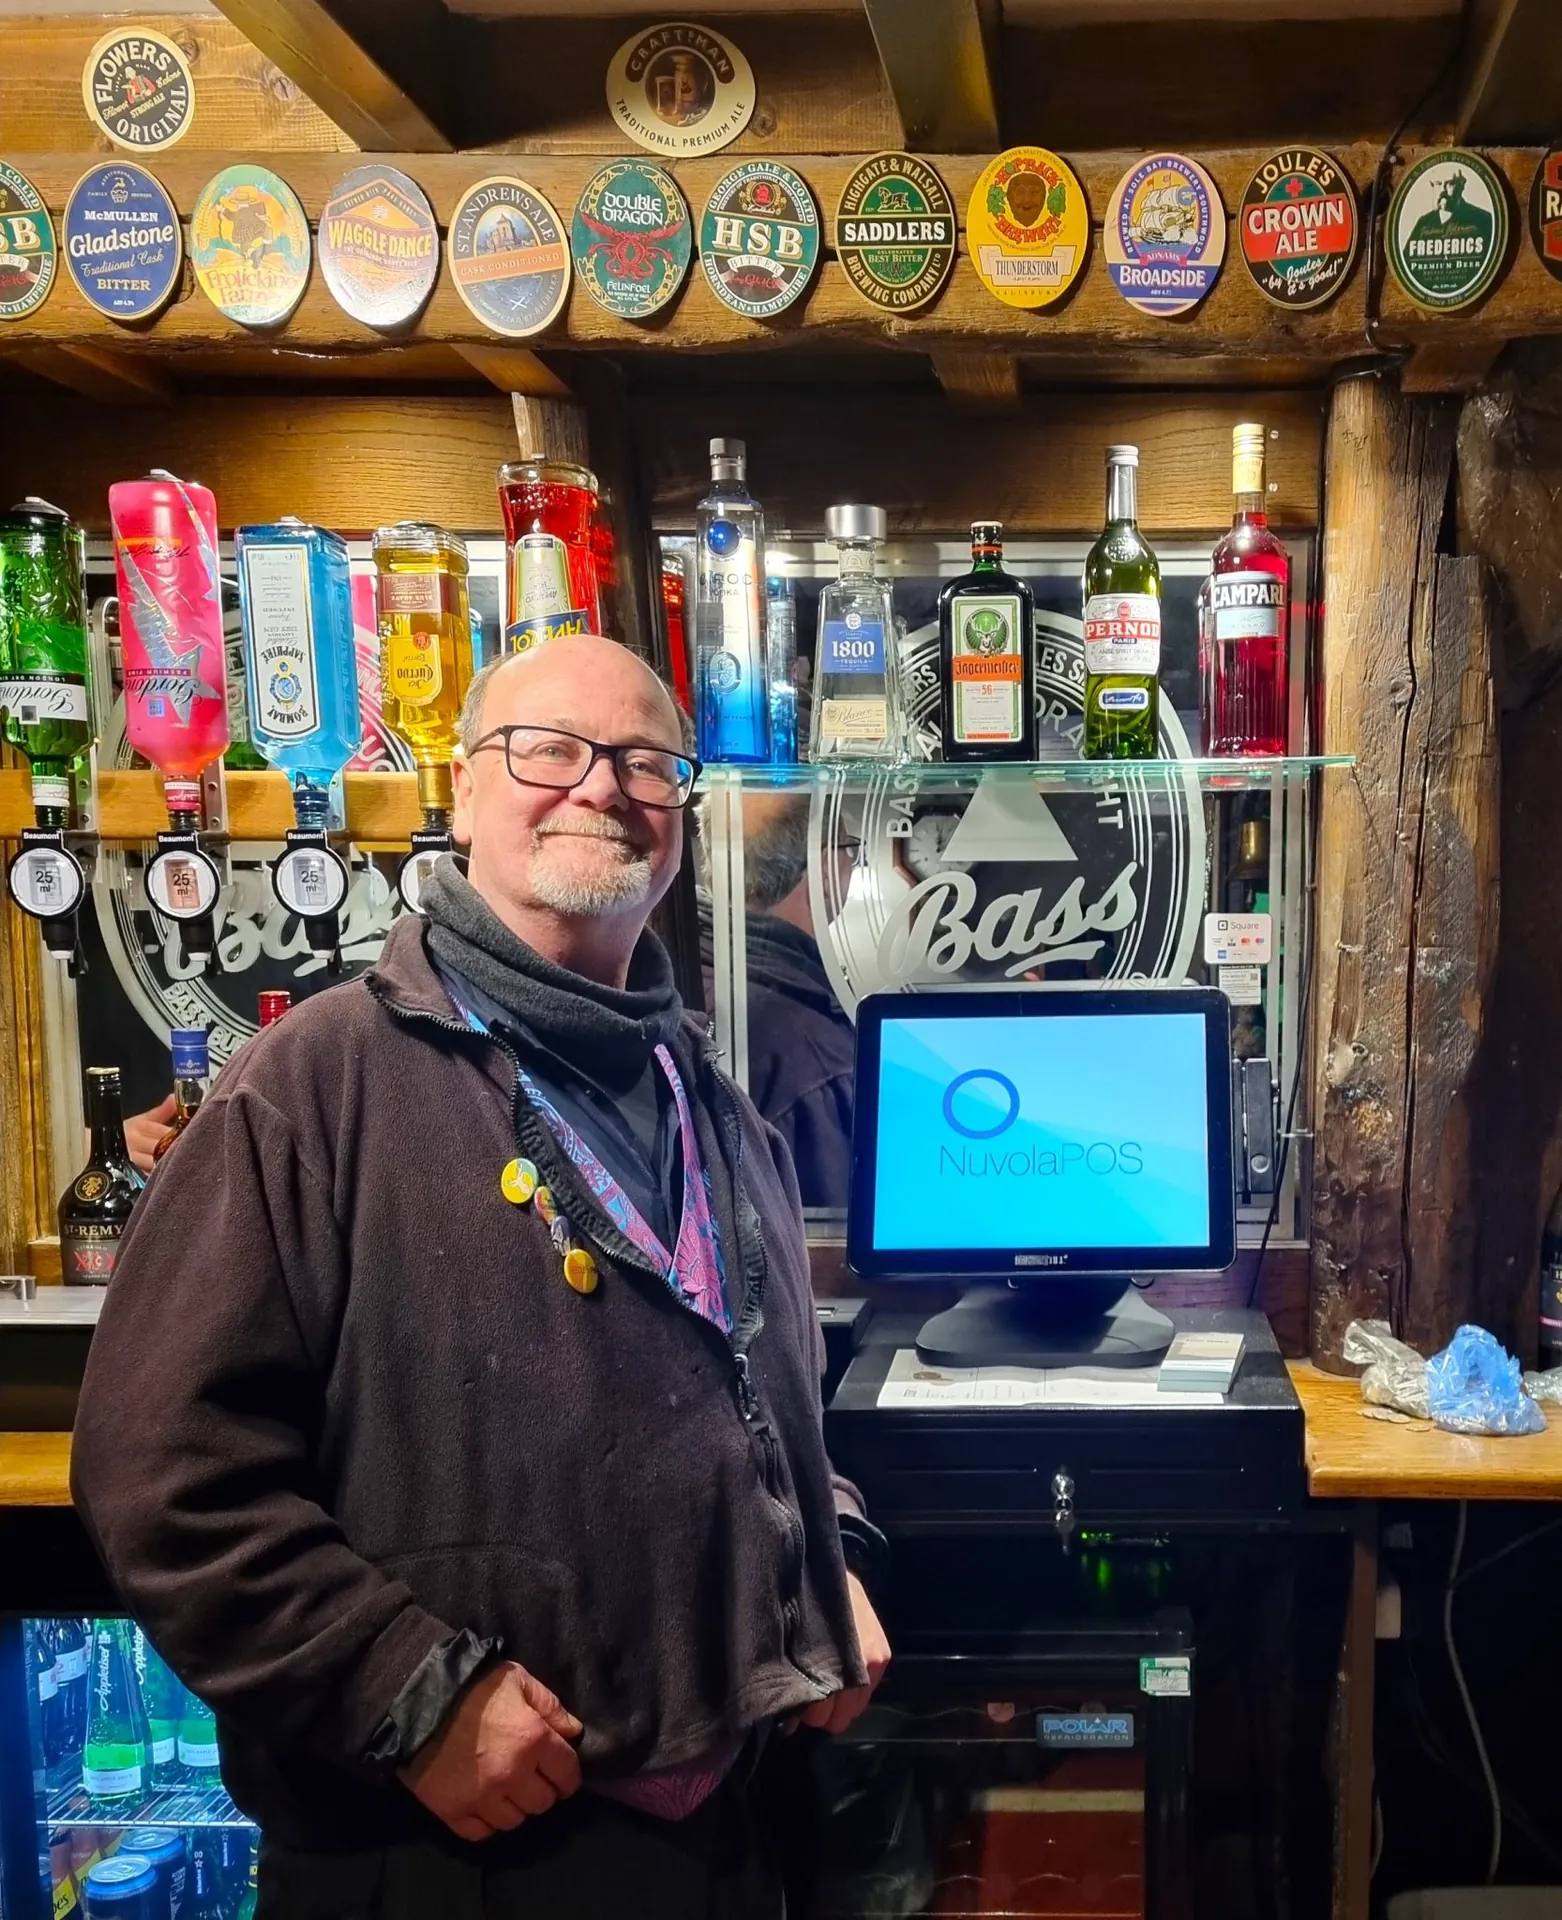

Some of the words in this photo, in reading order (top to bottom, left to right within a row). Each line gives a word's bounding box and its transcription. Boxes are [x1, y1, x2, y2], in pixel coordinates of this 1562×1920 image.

[95, 40, 172, 104] FLOWERS
[116, 84, 187, 142] ORIGINAL
[130, 98, 155, 119] STRONG
[153, 92, 166, 107] ALE
[616, 98, 677, 147] TRADITIONAL
[682, 122, 730, 147] PREMIUM
[733, 101, 745, 124] ALE
[1146, 160, 1163, 173] BAY
[1166, 160, 1202, 191] BREWERY
[1254, 152, 1336, 195] JOULE'S
[708, 167, 746, 210] GEORGE
[747, 162, 780, 175] GALE
[782, 172, 791, 182] &
[844, 159, 889, 212] HIGHGATE
[889, 157, 900, 172] &
[902, 160, 944, 210] WALSALL
[1128, 171, 1145, 194] SOLE
[1123, 198, 1131, 210] AT
[84, 210, 159, 223] McMULLEN
[530, 208, 556, 242] ALE
[1194, 193, 1208, 254] SOUTHWOLD
[1248, 200, 1344, 235] CROWN
[70, 224, 174, 258] Gladstone
[328, 219, 388, 257] WAGGLE
[388, 233, 432, 258] DANCE
[711, 216, 803, 260] HSB
[844, 221, 946, 242] SADDLERS
[1121, 213, 1134, 254] BREWED
[1276, 229, 1319, 255] ALE
[1147, 250, 1181, 262] ADNAMS
[1409, 236, 1484, 257] FREDERICS
[80, 258, 137, 278] Traditional
[137, 249, 166, 267] Cask
[460, 263, 485, 276] CASK
[488, 253, 560, 271] CONDITIONED
[729, 255, 781, 274] BITTER
[868, 254, 890, 263] BEST
[892, 254, 923, 263] BITTER
[996, 260, 1059, 276] THUNDERSTORM
[1410, 262, 1453, 271] PREMIUM
[1455, 260, 1481, 269] BEER
[846, 255, 890, 303] BREWING
[892, 267, 940, 305] COMPANY
[1119, 265, 1206, 287] BROADSIDE
[1286, 258, 1323, 285] Joules
[12, 258, 53, 313] HAMPSHIRE
[97, 278, 151, 292] BITTER
[1212, 583, 1285, 608] CAMPARI
[1086, 621, 1160, 638] PERNOD
[260, 645, 306, 664] SAPPHIRE
[832, 640, 875, 658] 1800
[981, 684, 993, 695] 56
[266, 704, 309, 725] BOMBAY
[23, 831, 60, 840] Beaumont
[158, 834, 195, 843] Beaumont
[287, 831, 324, 840] Beaumont
[412, 834, 449, 843] Beaumont
[35, 870, 54, 884] 25
[172, 873, 190, 887] 25
[301, 870, 319, 883] 25
[39, 885, 52, 893] ml
[176, 887, 189, 895] ml
[305, 885, 318, 893] ml
[877, 860, 1139, 984] Bass
[1230, 921, 1260, 931] Square
[939, 1141, 1144, 1178] NuvolaPOS
[94, 1643, 112, 1712] Appletiser
[1043, 1719, 1129, 1735] POLAR
